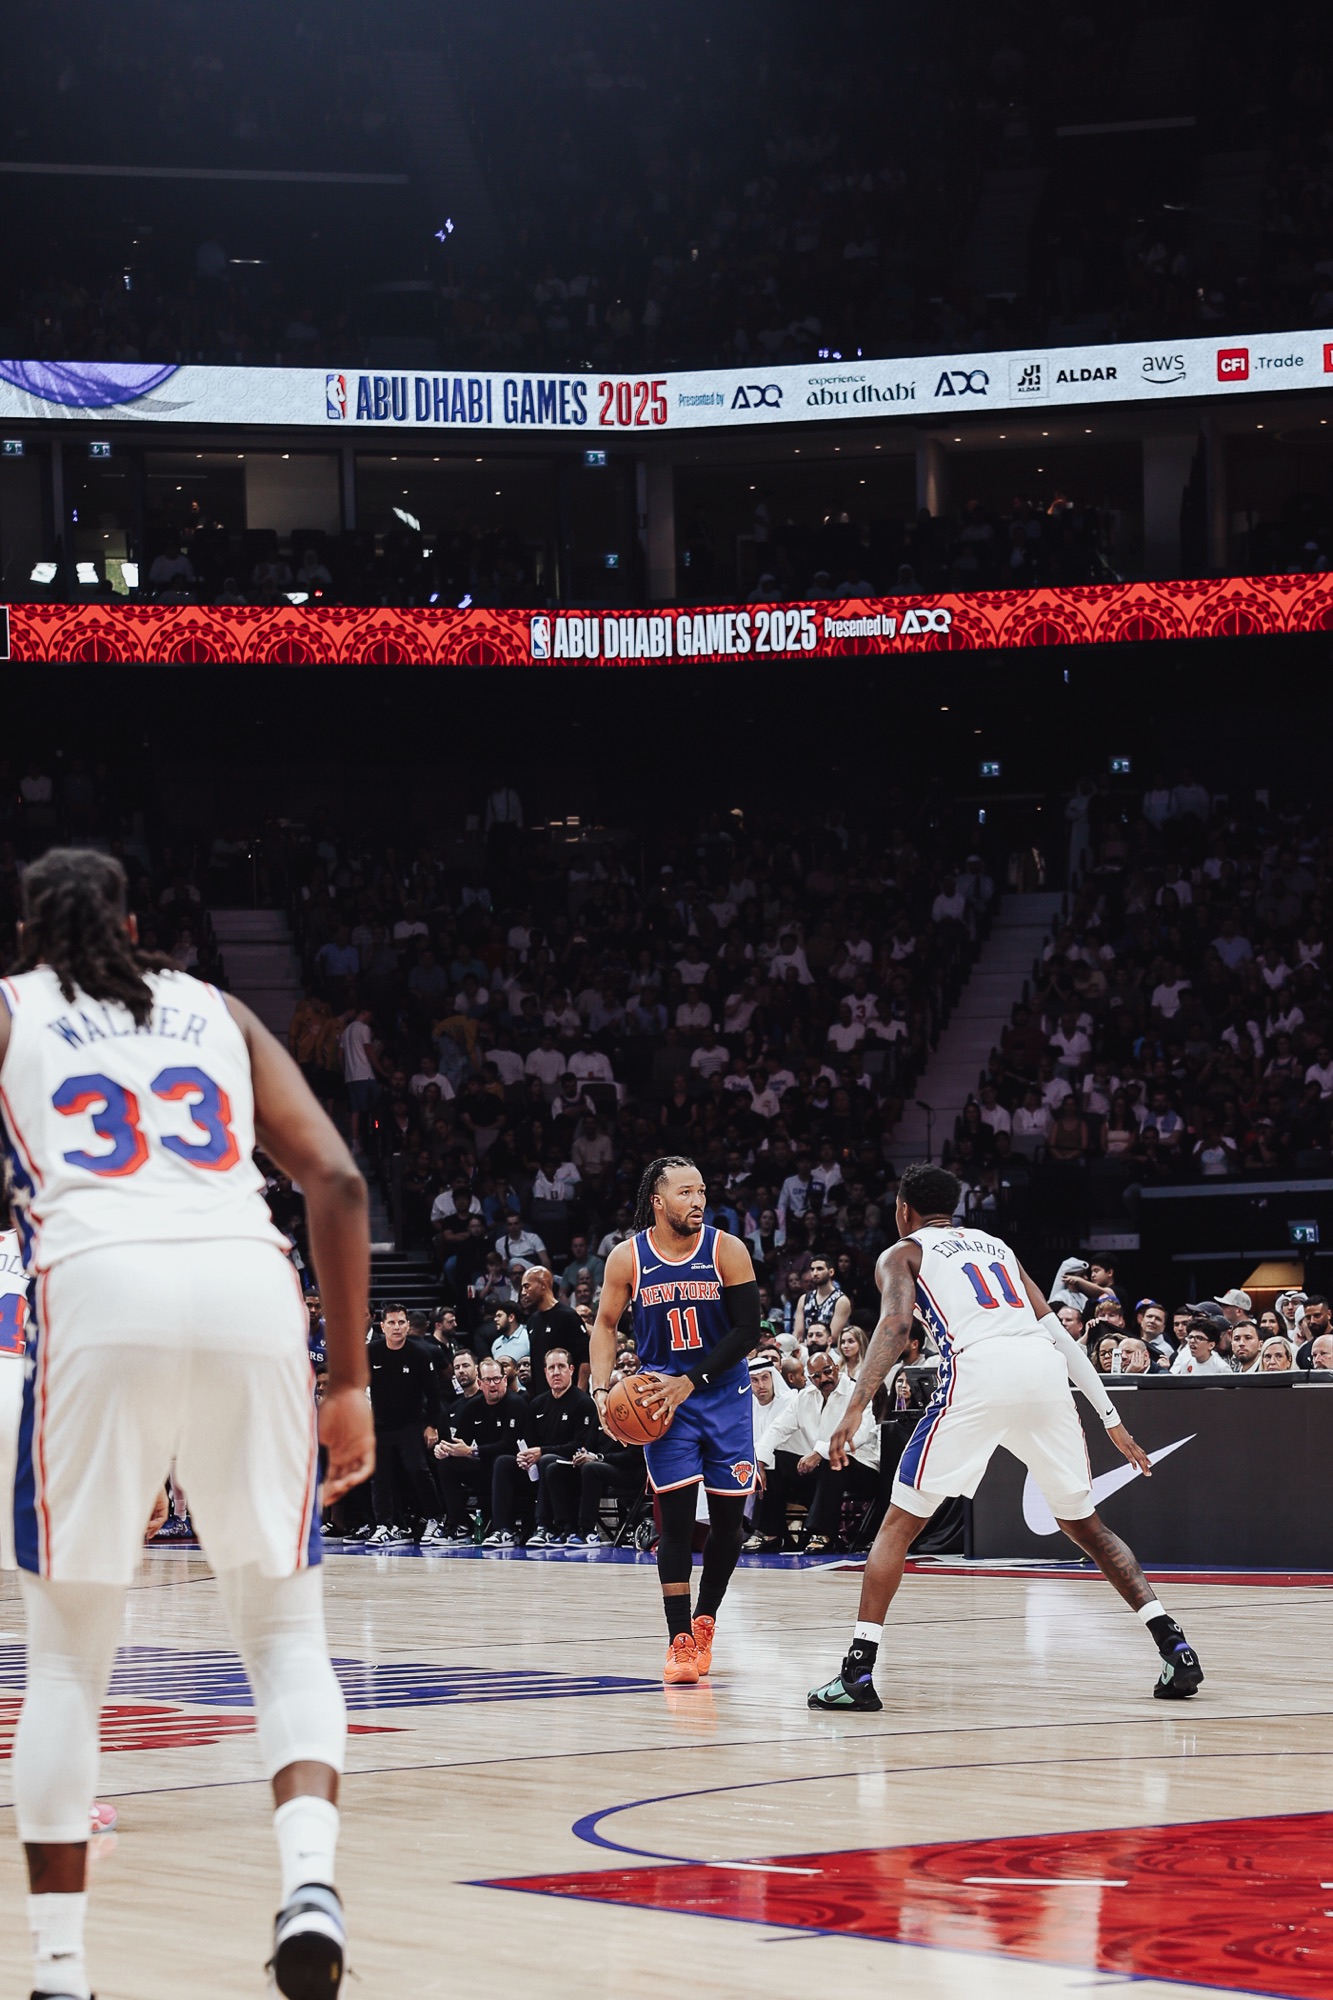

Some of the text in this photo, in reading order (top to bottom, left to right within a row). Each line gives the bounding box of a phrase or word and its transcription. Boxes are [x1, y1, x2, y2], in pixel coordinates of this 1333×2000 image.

[1056, 367, 1117, 384] ALDAR
[1142, 354, 1185, 373] aws
[1220, 357, 1246, 373] CFI
[808, 374, 866, 386] experience
[934, 369, 990, 396] ADQ
[356, 375, 668, 426] ABU DHABI GAMES 2025
[678, 392, 725, 407] Presented by
[731, 384, 783, 409] ADQ
[806, 386, 847, 406] abu
[553, 608, 952, 658] ABU DHABI GAMES 2025 Presented by ADQ
[48, 1006, 208, 1050] WALER
[51, 1066, 240, 1177] 33
[932, 1240, 1006, 1260] EDWARDS
[639, 1281, 720, 1307] NEW YORK
[961, 1262, 1025, 1309] 11
[667, 1306, 703, 1351] 11
